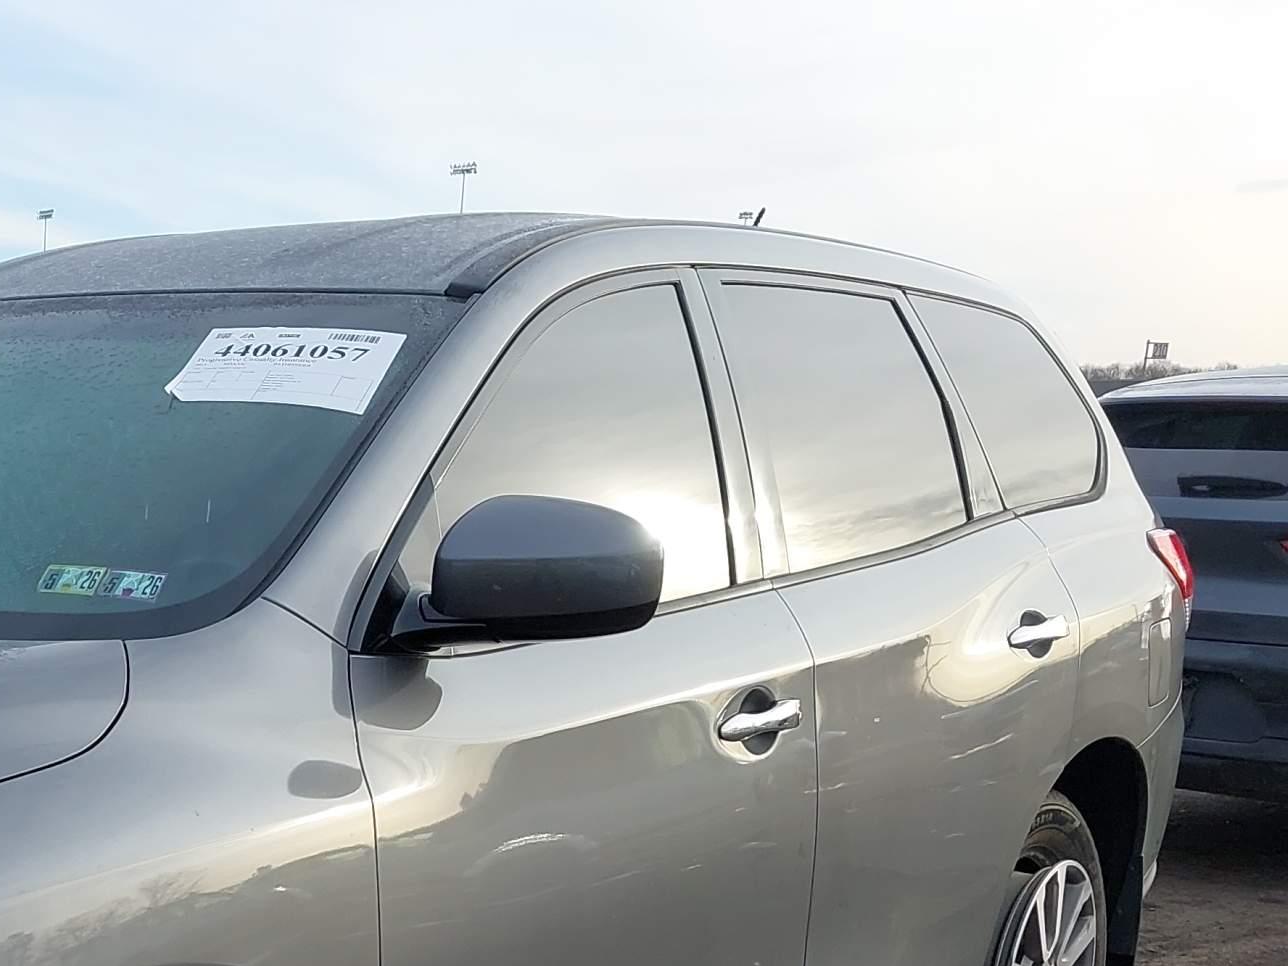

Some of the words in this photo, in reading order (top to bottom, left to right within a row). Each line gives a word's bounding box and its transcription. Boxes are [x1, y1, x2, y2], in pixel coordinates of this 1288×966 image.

[214, 342, 370, 363] 44061057
[80, 570, 101, 589] 26
[142, 575, 163, 596] 26
